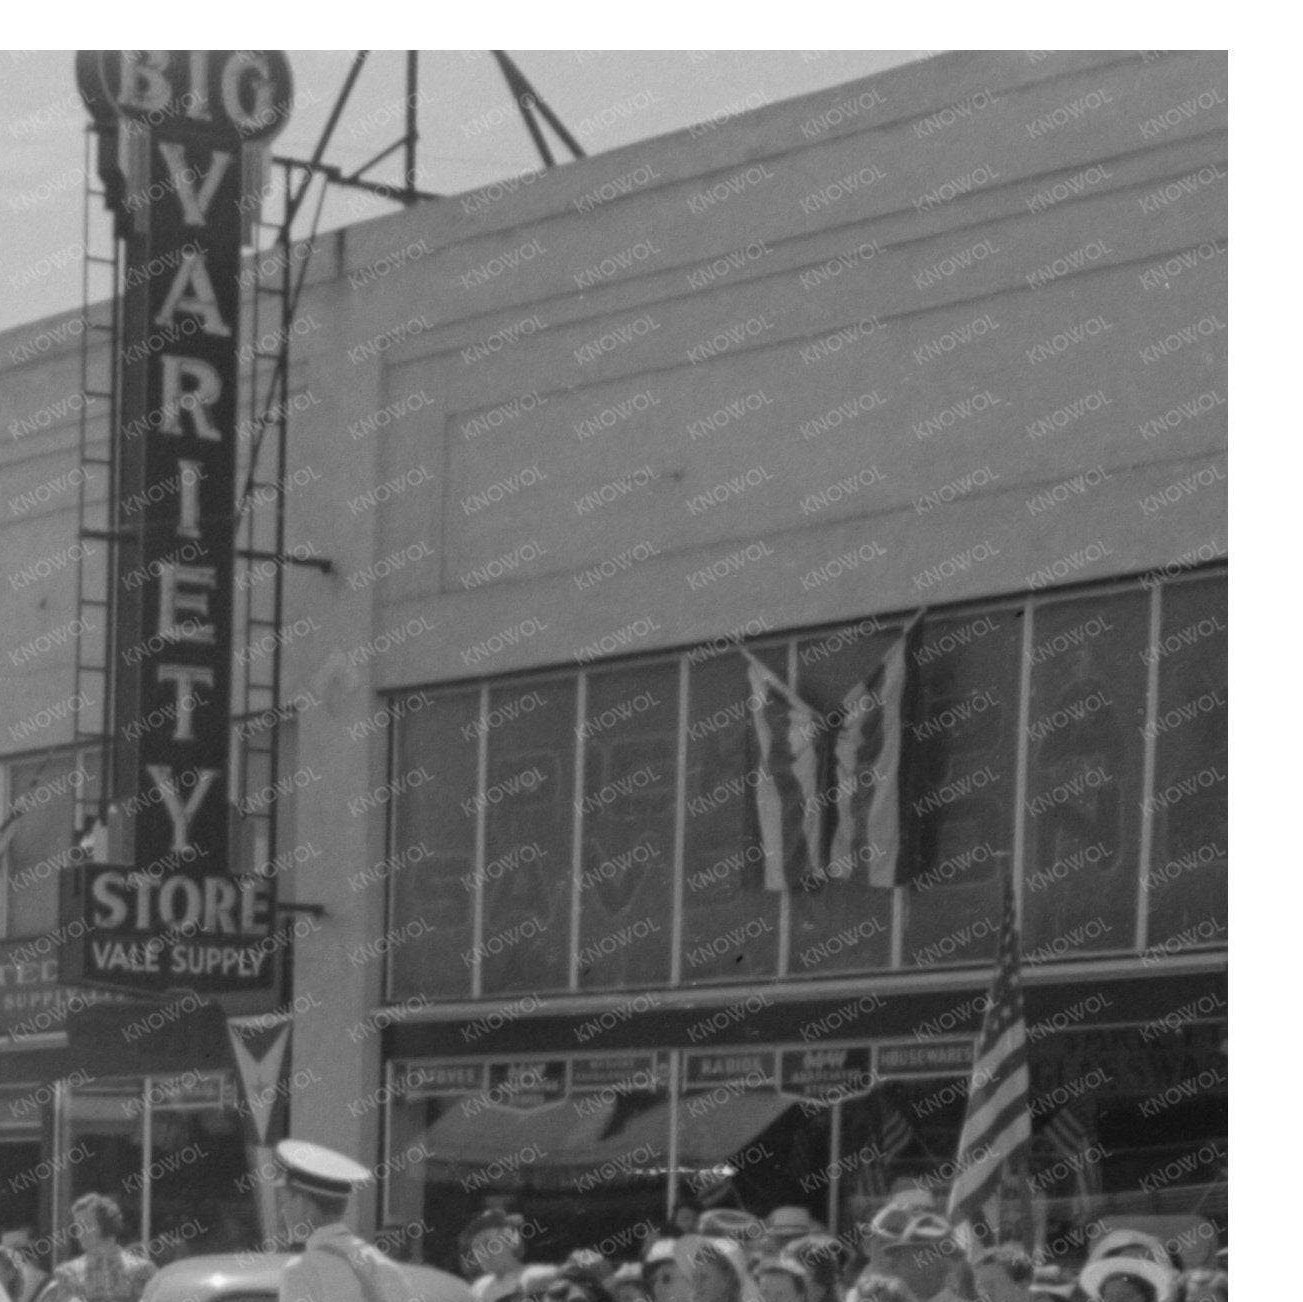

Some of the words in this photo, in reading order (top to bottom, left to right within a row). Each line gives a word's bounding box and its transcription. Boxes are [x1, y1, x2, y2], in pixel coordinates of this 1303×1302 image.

[118, 50, 277, 129] BIG
[147, 142, 233, 853] VARIETY
[93, 872, 272, 936] STORE
[92, 941, 161, 973] VALE
[171, 945, 267, 978] SUPPLY
